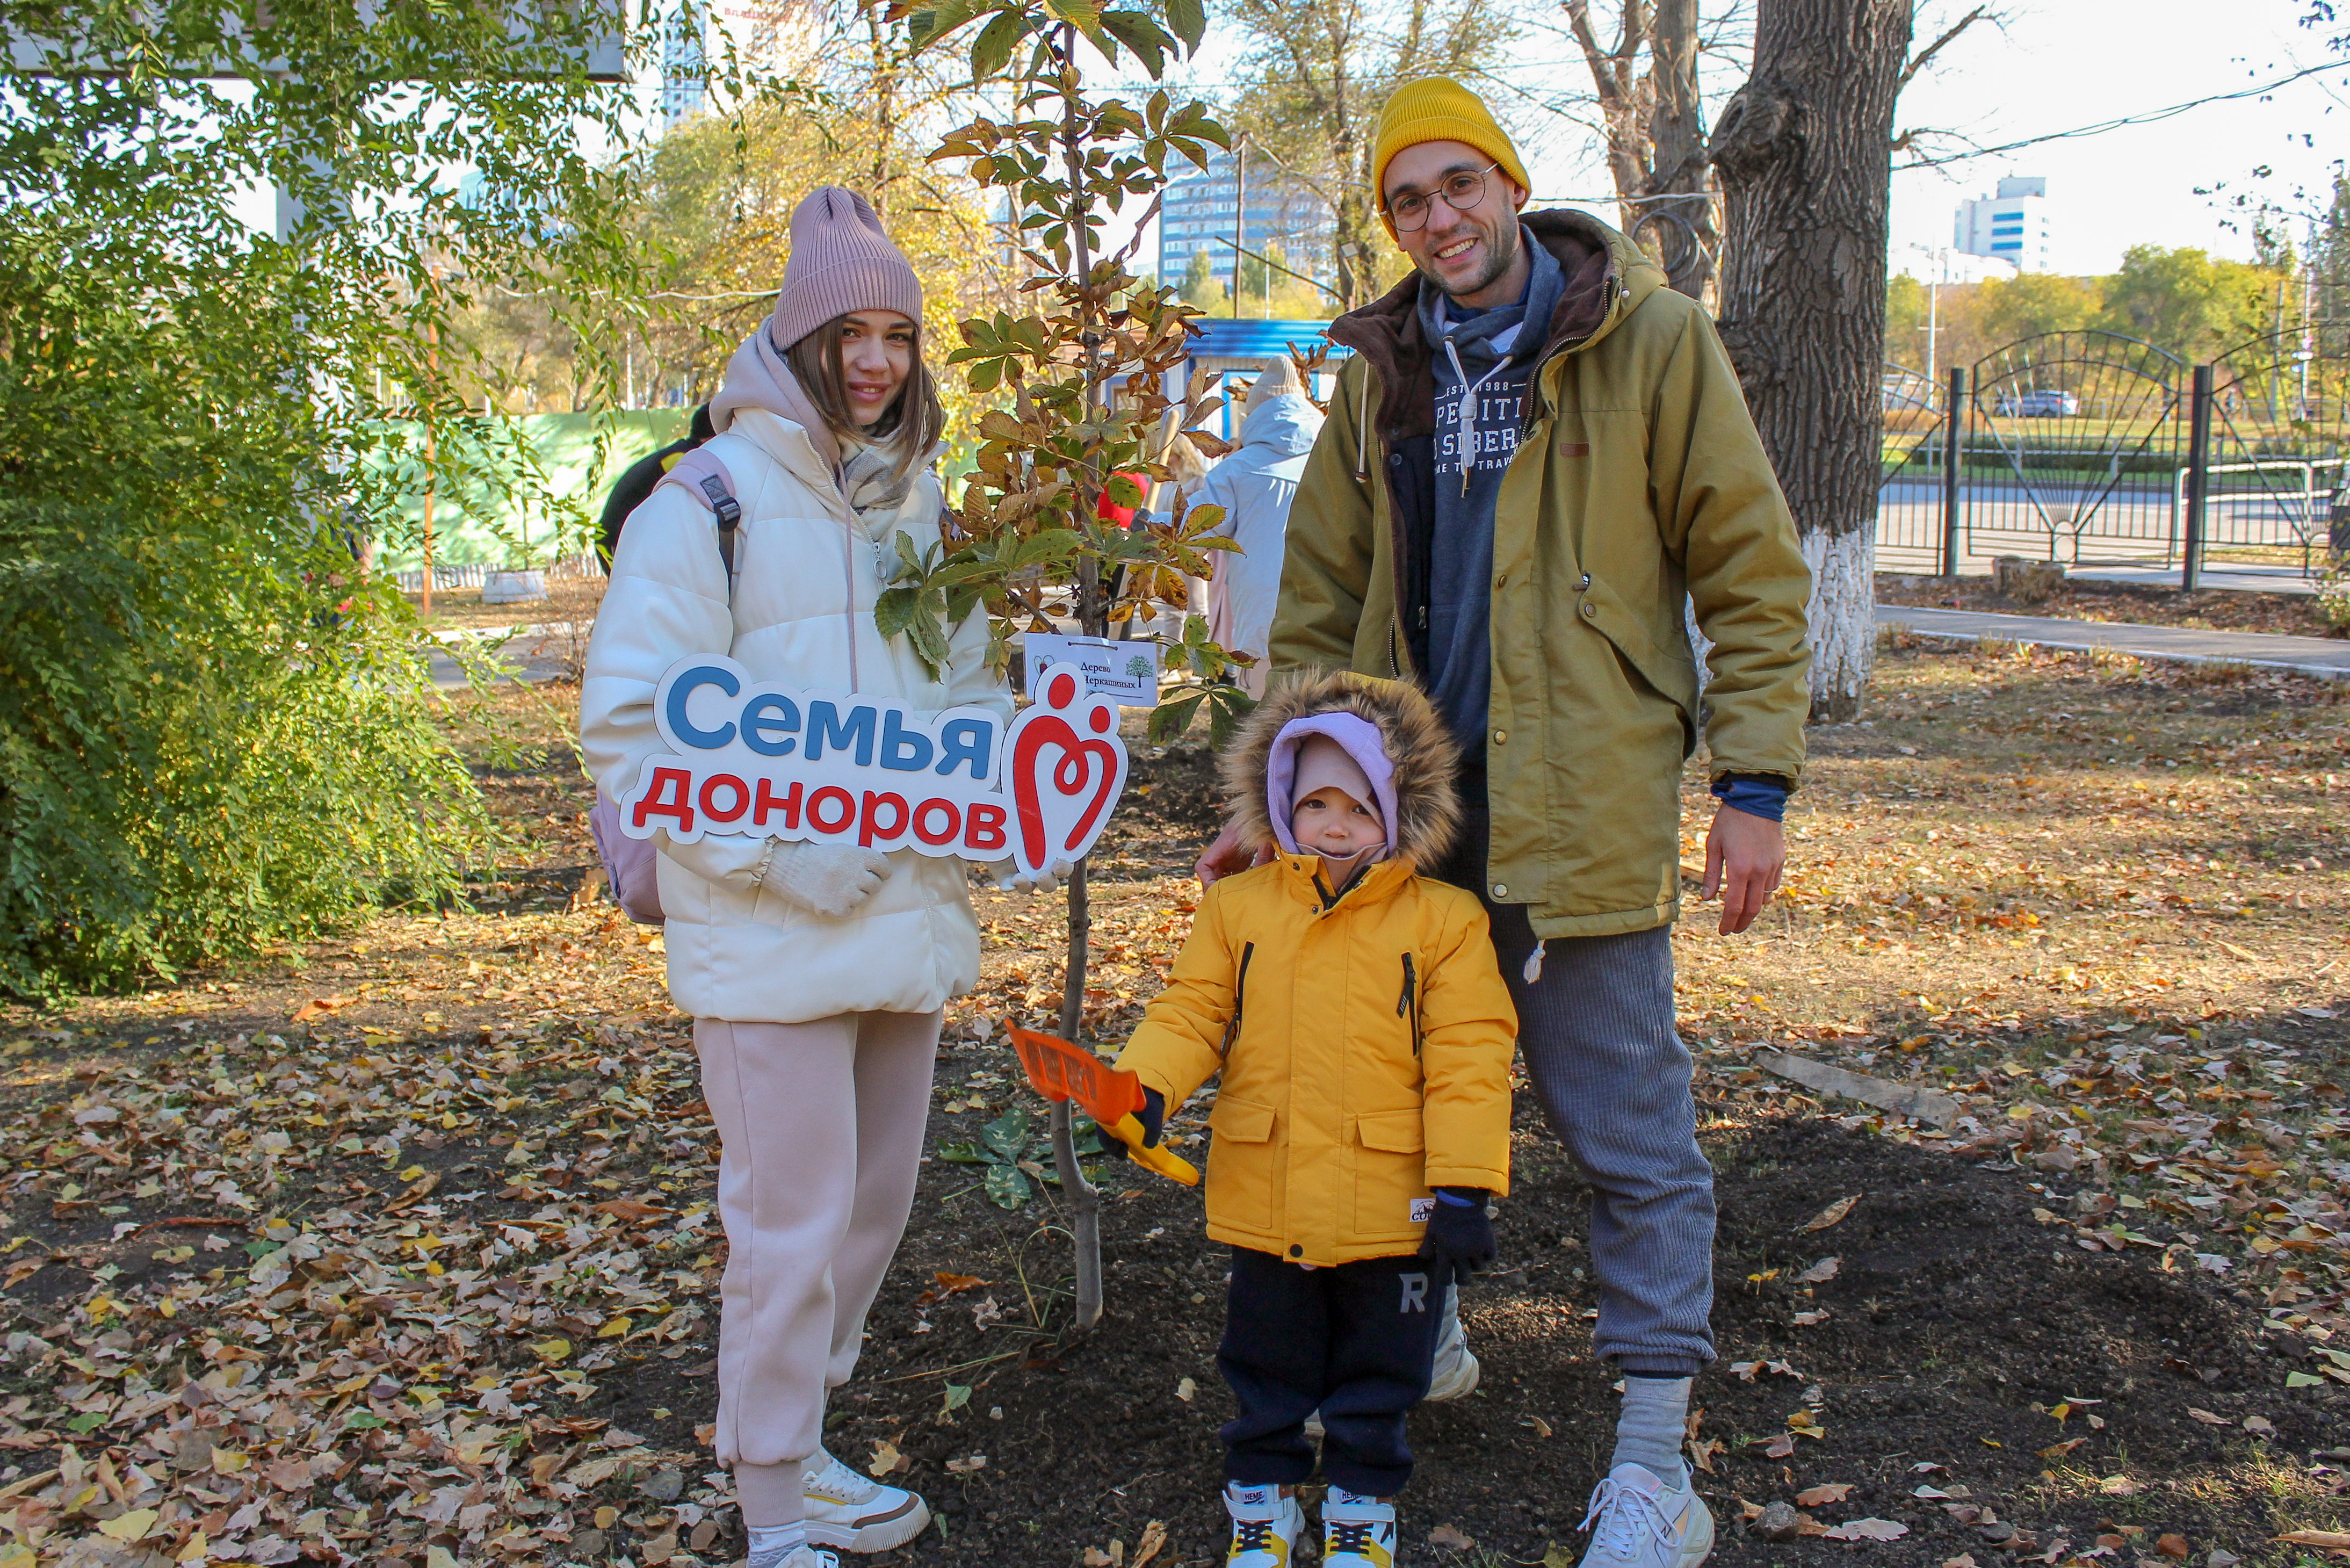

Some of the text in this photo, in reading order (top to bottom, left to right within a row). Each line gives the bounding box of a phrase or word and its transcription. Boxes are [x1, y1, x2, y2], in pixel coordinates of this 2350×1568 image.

[1478, 381, 1509, 392] 1988
[1436, 397, 1522, 428] PEITI
[1080, 662, 1111, 675] Дерево
[667, 666, 993, 779] Семья
[632, 767, 1007, 850] доноров
[1398, 1273, 1428, 1313] R
